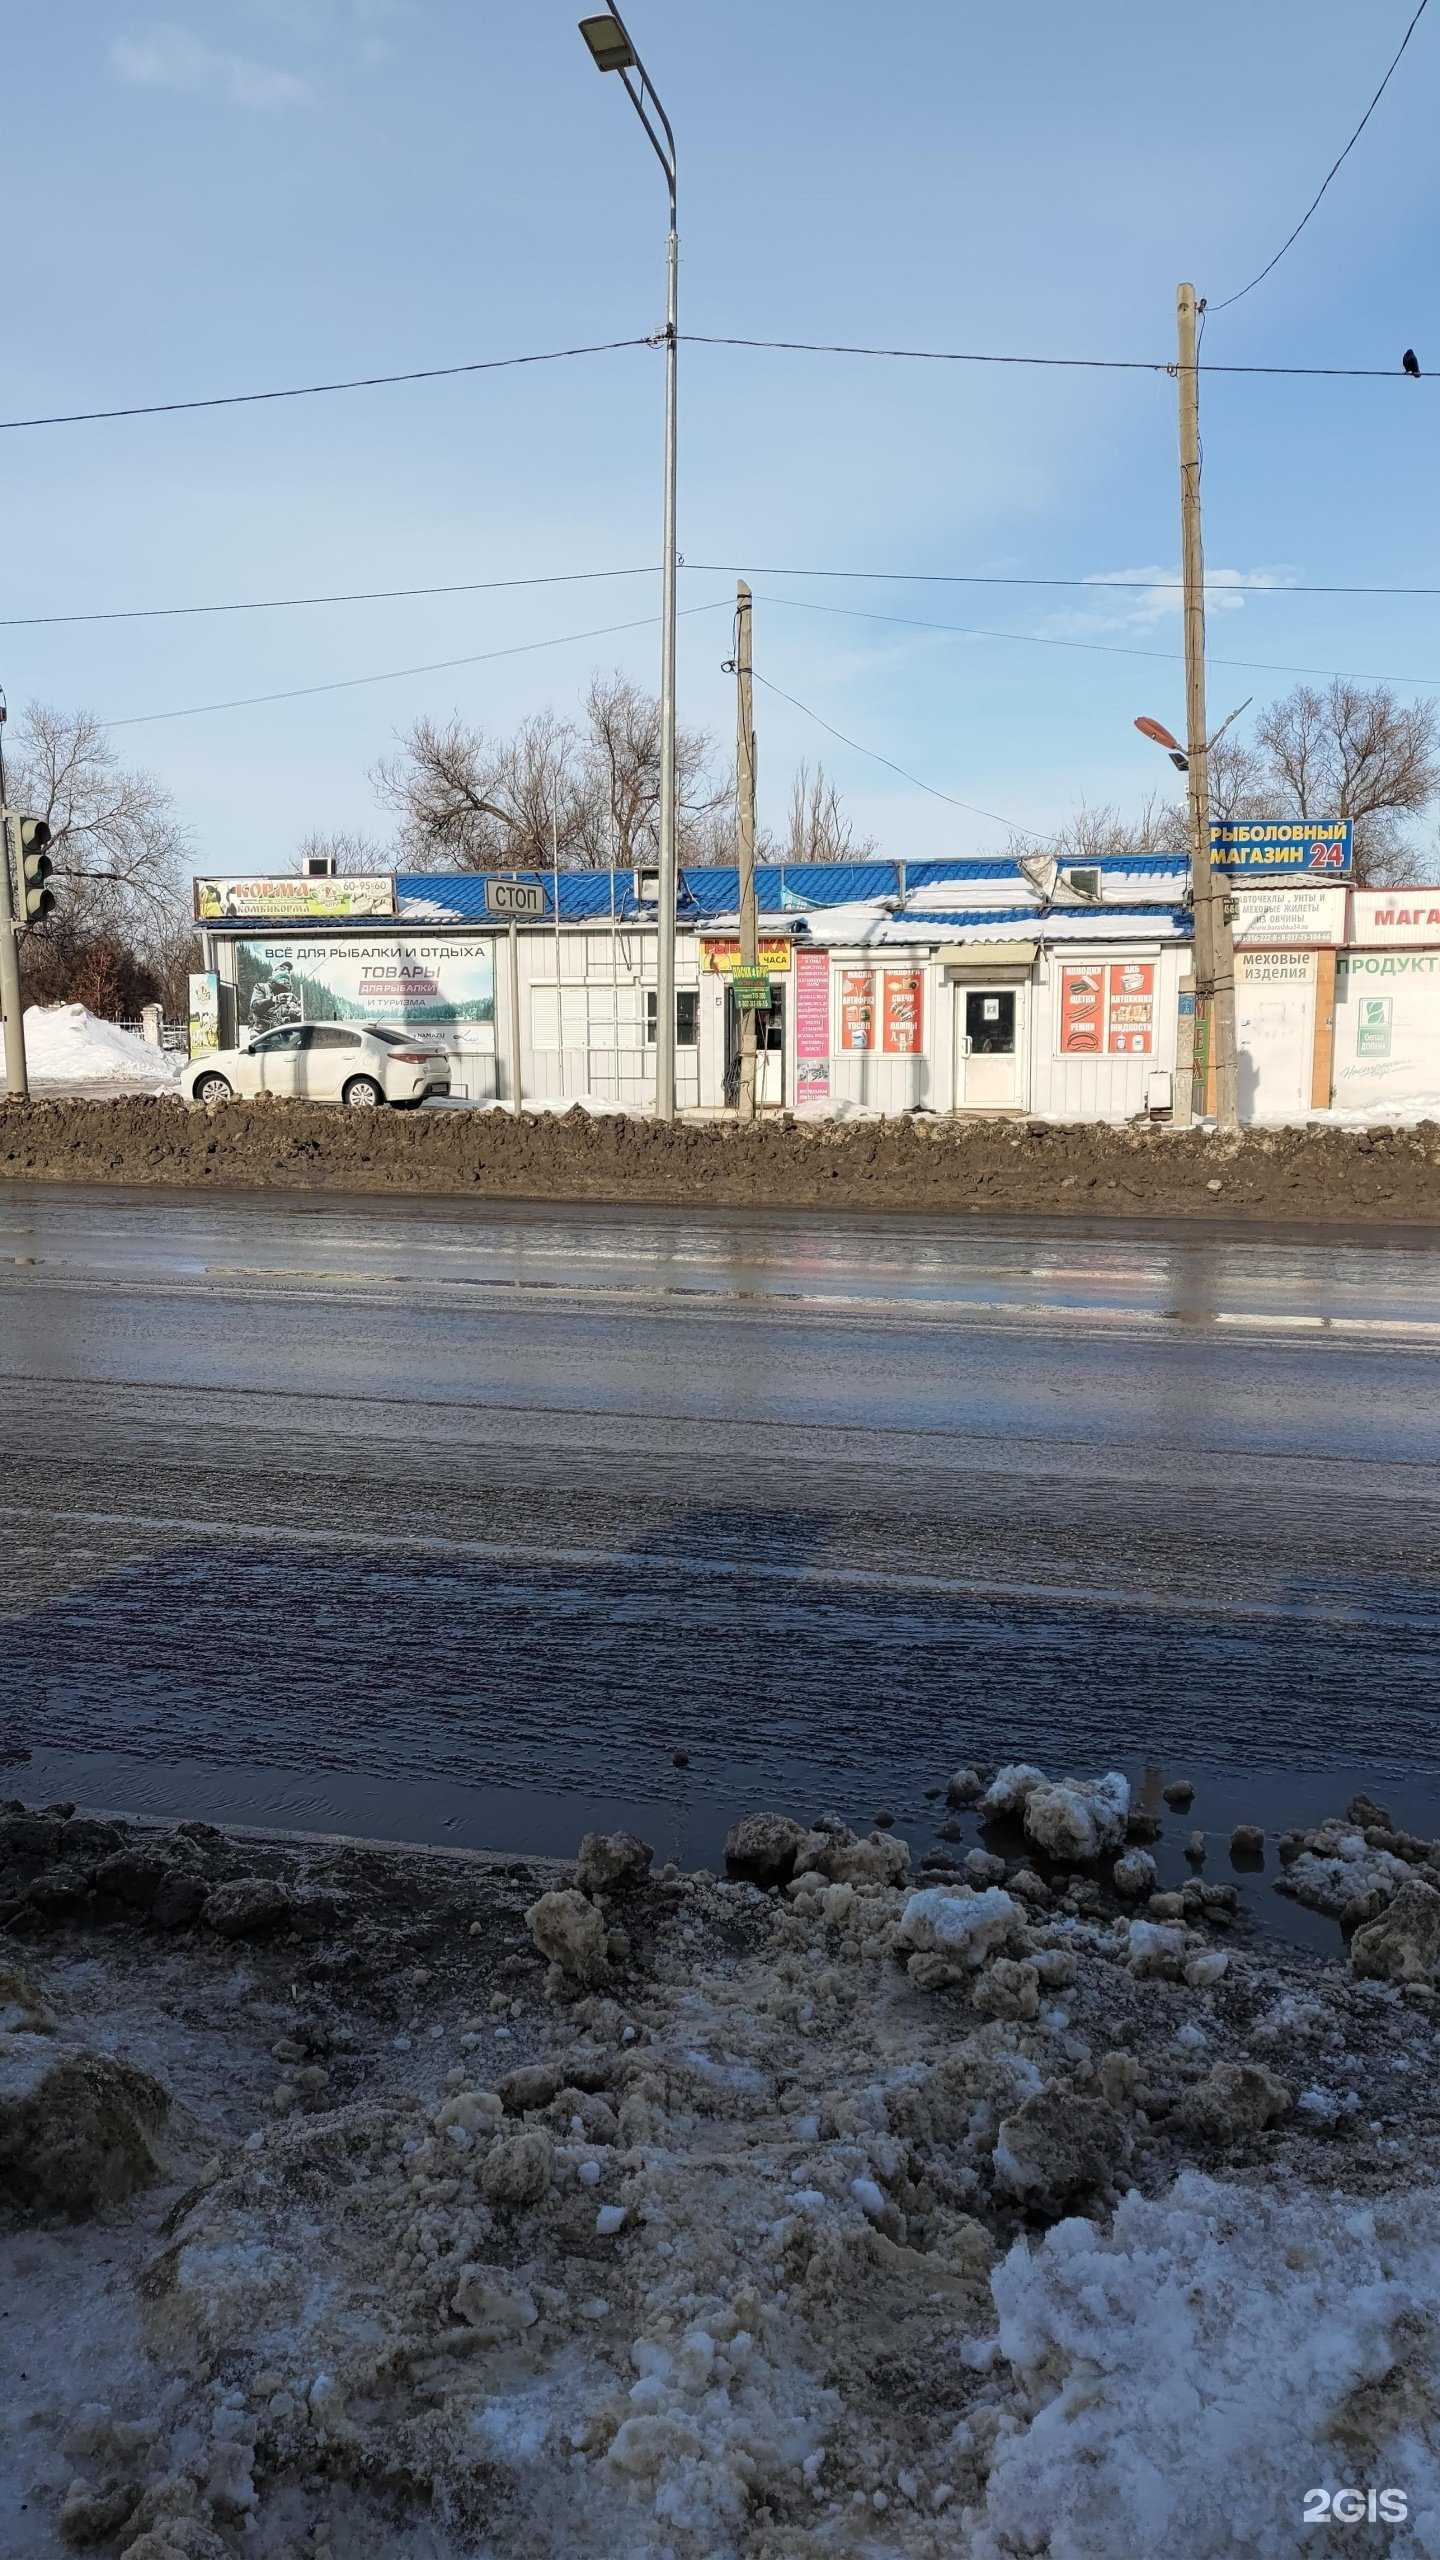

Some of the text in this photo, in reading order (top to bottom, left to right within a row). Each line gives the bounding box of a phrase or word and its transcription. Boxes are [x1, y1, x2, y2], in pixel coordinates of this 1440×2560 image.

[1210, 822, 1347, 842] РЫБОЛОВНЫЙ
[1210, 843, 1344, 868] МАГАЗИН 24
[236, 883, 310, 898] КОРМА
[344, 881, 387, 891] 60-95-60
[495, 886, 537, 910] СТОП
[237, 903, 310, 913] КОМБИКОРМА
[1269, 914, 1305, 923] ОВЧИНЫ
[1374, 909, 1440, 926] МАГА
[265, 946, 486, 959] ВСЁ ДЛЯ РЫБАЛКИ И ОТДЫХА
[1242, 953, 1311, 965] меховые
[764, 956, 788, 964] ЧАСА
[1336, 957, 1440, 976] ПРОДУКТ
[361, 966, 441, 979] ТОВАРЫ
[1245, 967, 1307, 981] изделия
[361, 984, 437, 993] ДЛЯ РЫБАЛКИ
[367, 999, 426, 1007] И ТУРИЗМА
